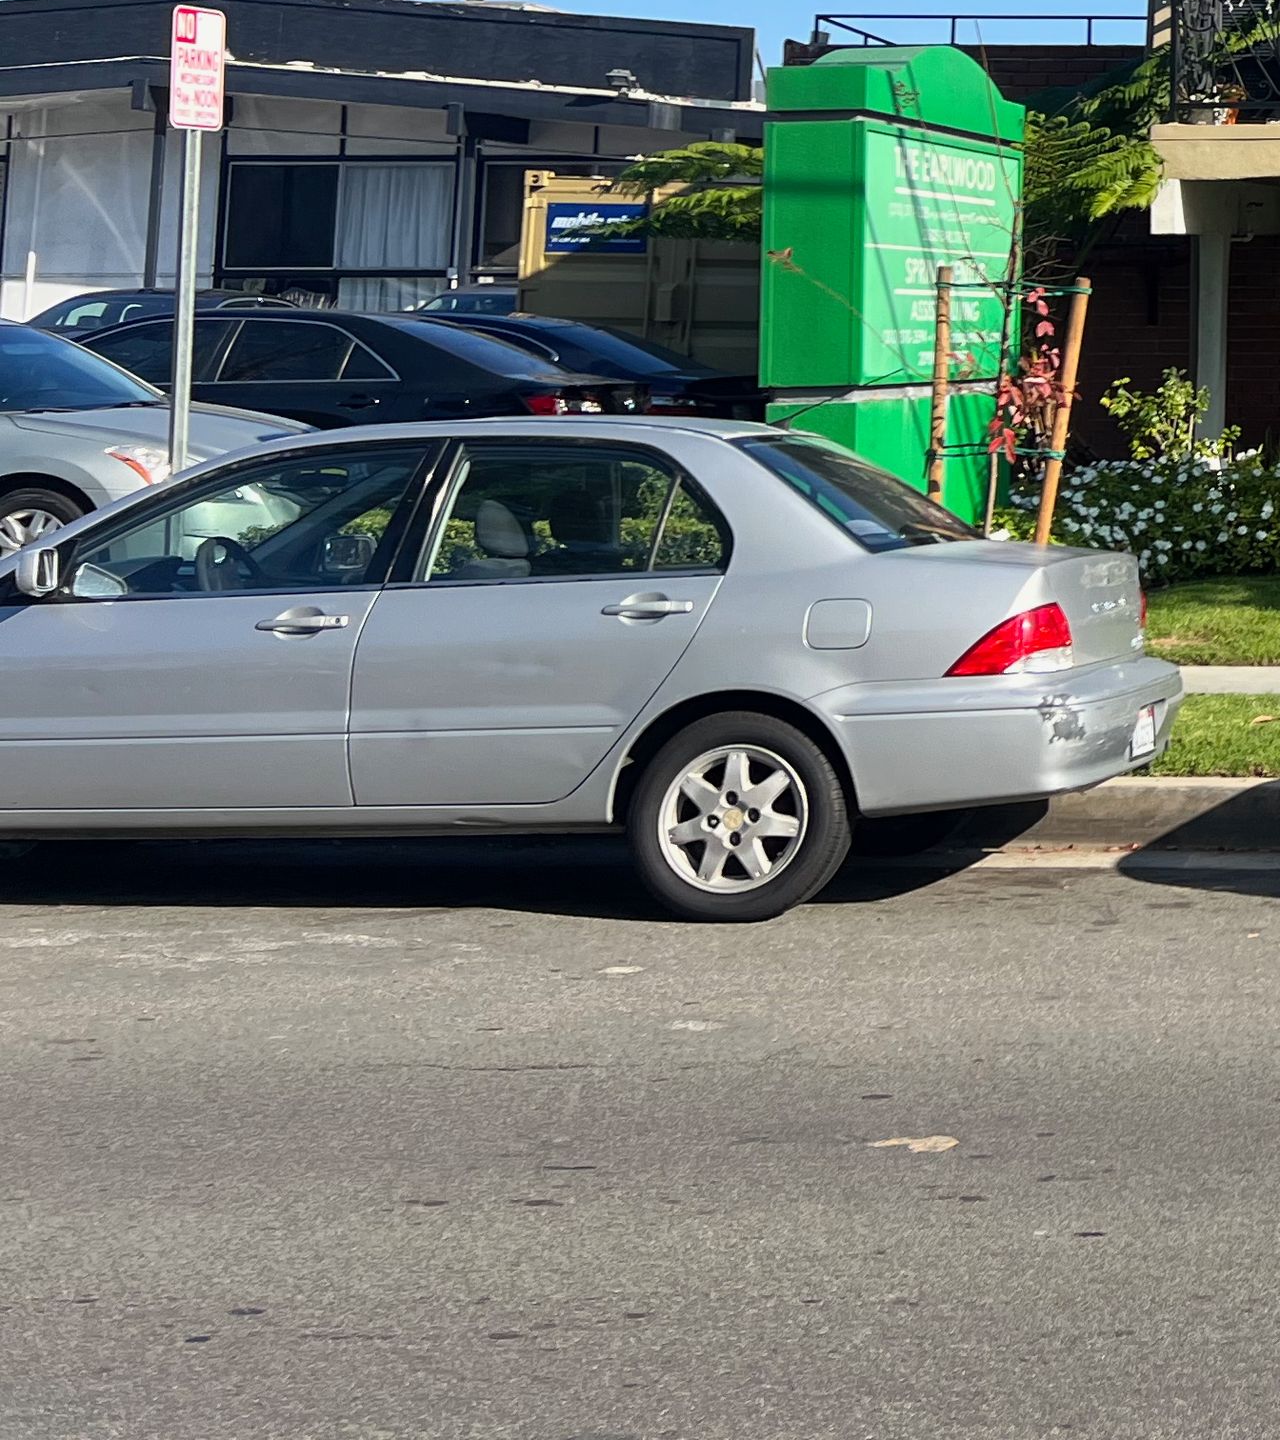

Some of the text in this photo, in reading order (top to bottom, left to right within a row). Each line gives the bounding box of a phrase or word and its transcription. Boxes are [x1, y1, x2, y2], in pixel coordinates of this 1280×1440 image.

[177, 13, 195, 40] NO
[178, 47, 219, 72] PARKING
[922, 151, 996, 192] EARLWOOD
